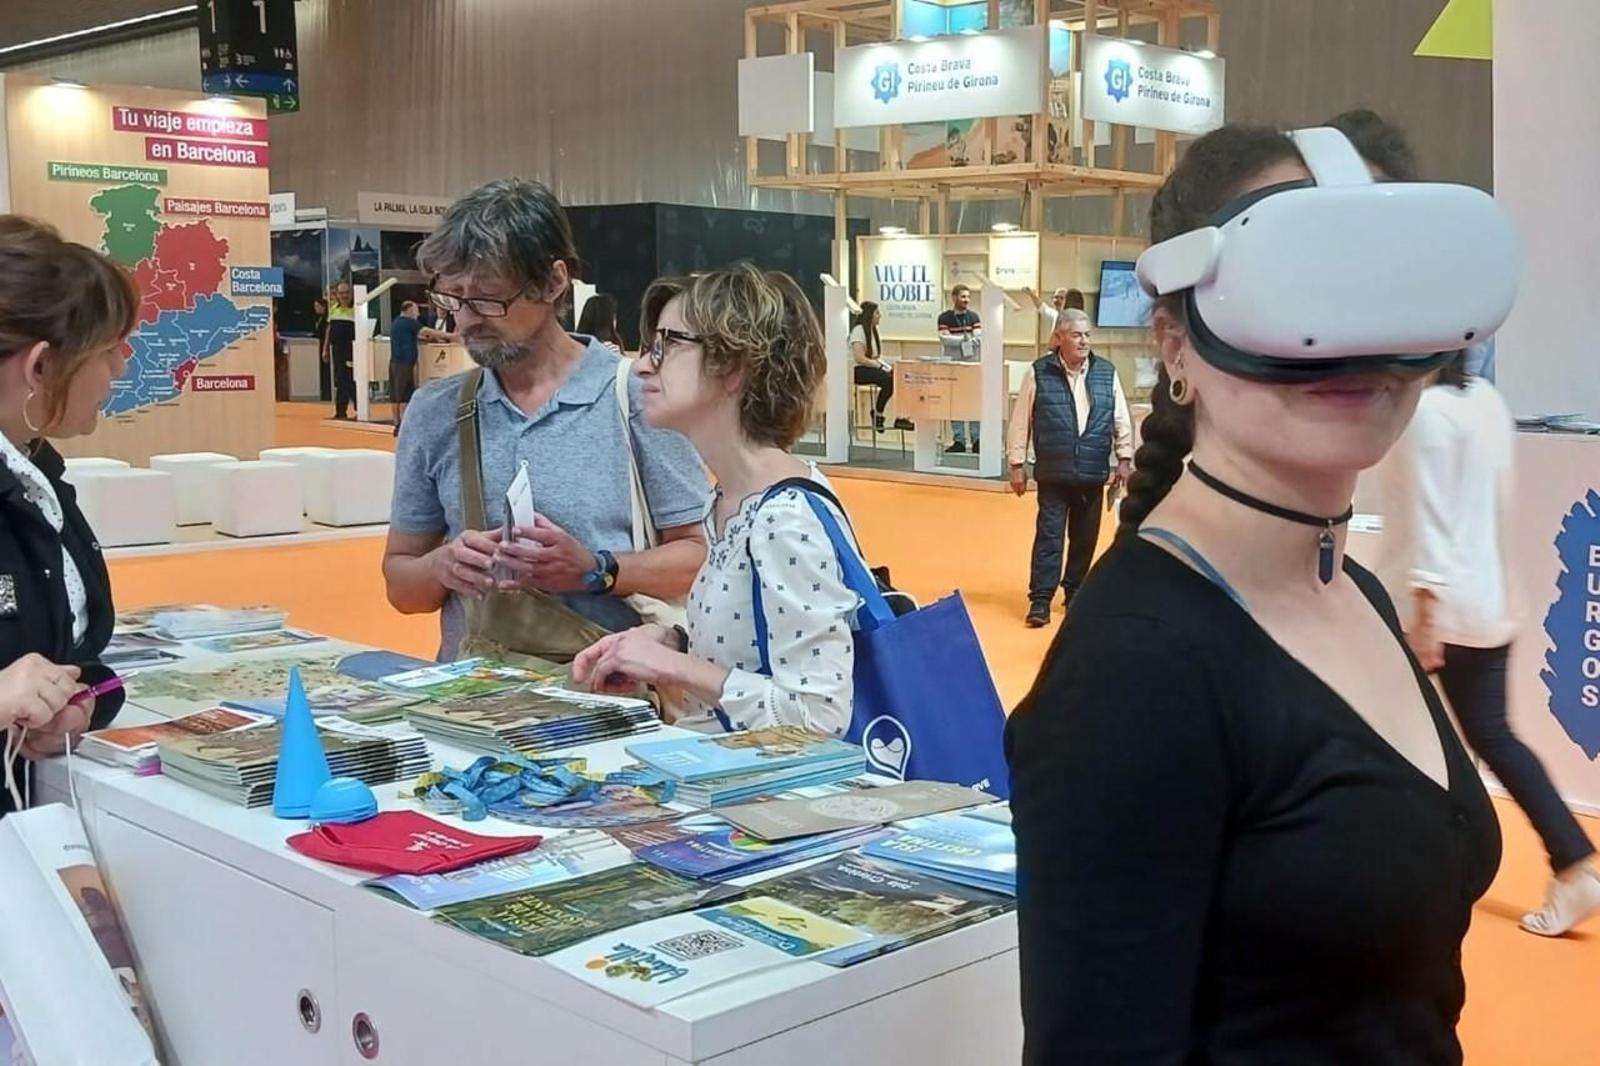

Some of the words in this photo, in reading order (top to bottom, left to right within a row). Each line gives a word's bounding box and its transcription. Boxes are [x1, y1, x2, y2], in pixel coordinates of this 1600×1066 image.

[908, 62, 937, 75] Costa
[941, 59, 971, 72] Brava
[907, 80, 945, 93] Pirineu
[947, 77, 960, 90] de
[963, 75, 998, 88] Girona
[1138, 66, 1163, 82] Costa
[1166, 71, 1191, 87] Brava
[1138, 85, 1169, 101] Pirineu
[1170, 90, 1182, 103] de
[1184, 92, 1211, 108] Girona
[119, 108, 139, 126] Tu
[144, 111, 182, 133] viaje
[187, 115, 254, 136] empieza
[152, 143, 172, 158] en
[177, 142, 257, 164] Barcelona
[52, 164, 100, 180] Pirineos
[103, 169, 159, 182] Barcelona
[167, 200, 211, 216] Paisajes
[214, 201, 266, 216] Barcelona
[374, 201, 382, 212] LA
[410, 204, 418, 214] LA
[231, 268, 260, 280] Costa
[875, 264, 908, 283] VIVE
[912, 264, 931, 283] EL
[232, 281, 283, 293] Barcelona
[880, 283, 936, 302] DOBLE
[196, 377, 248, 389] Barcelona
